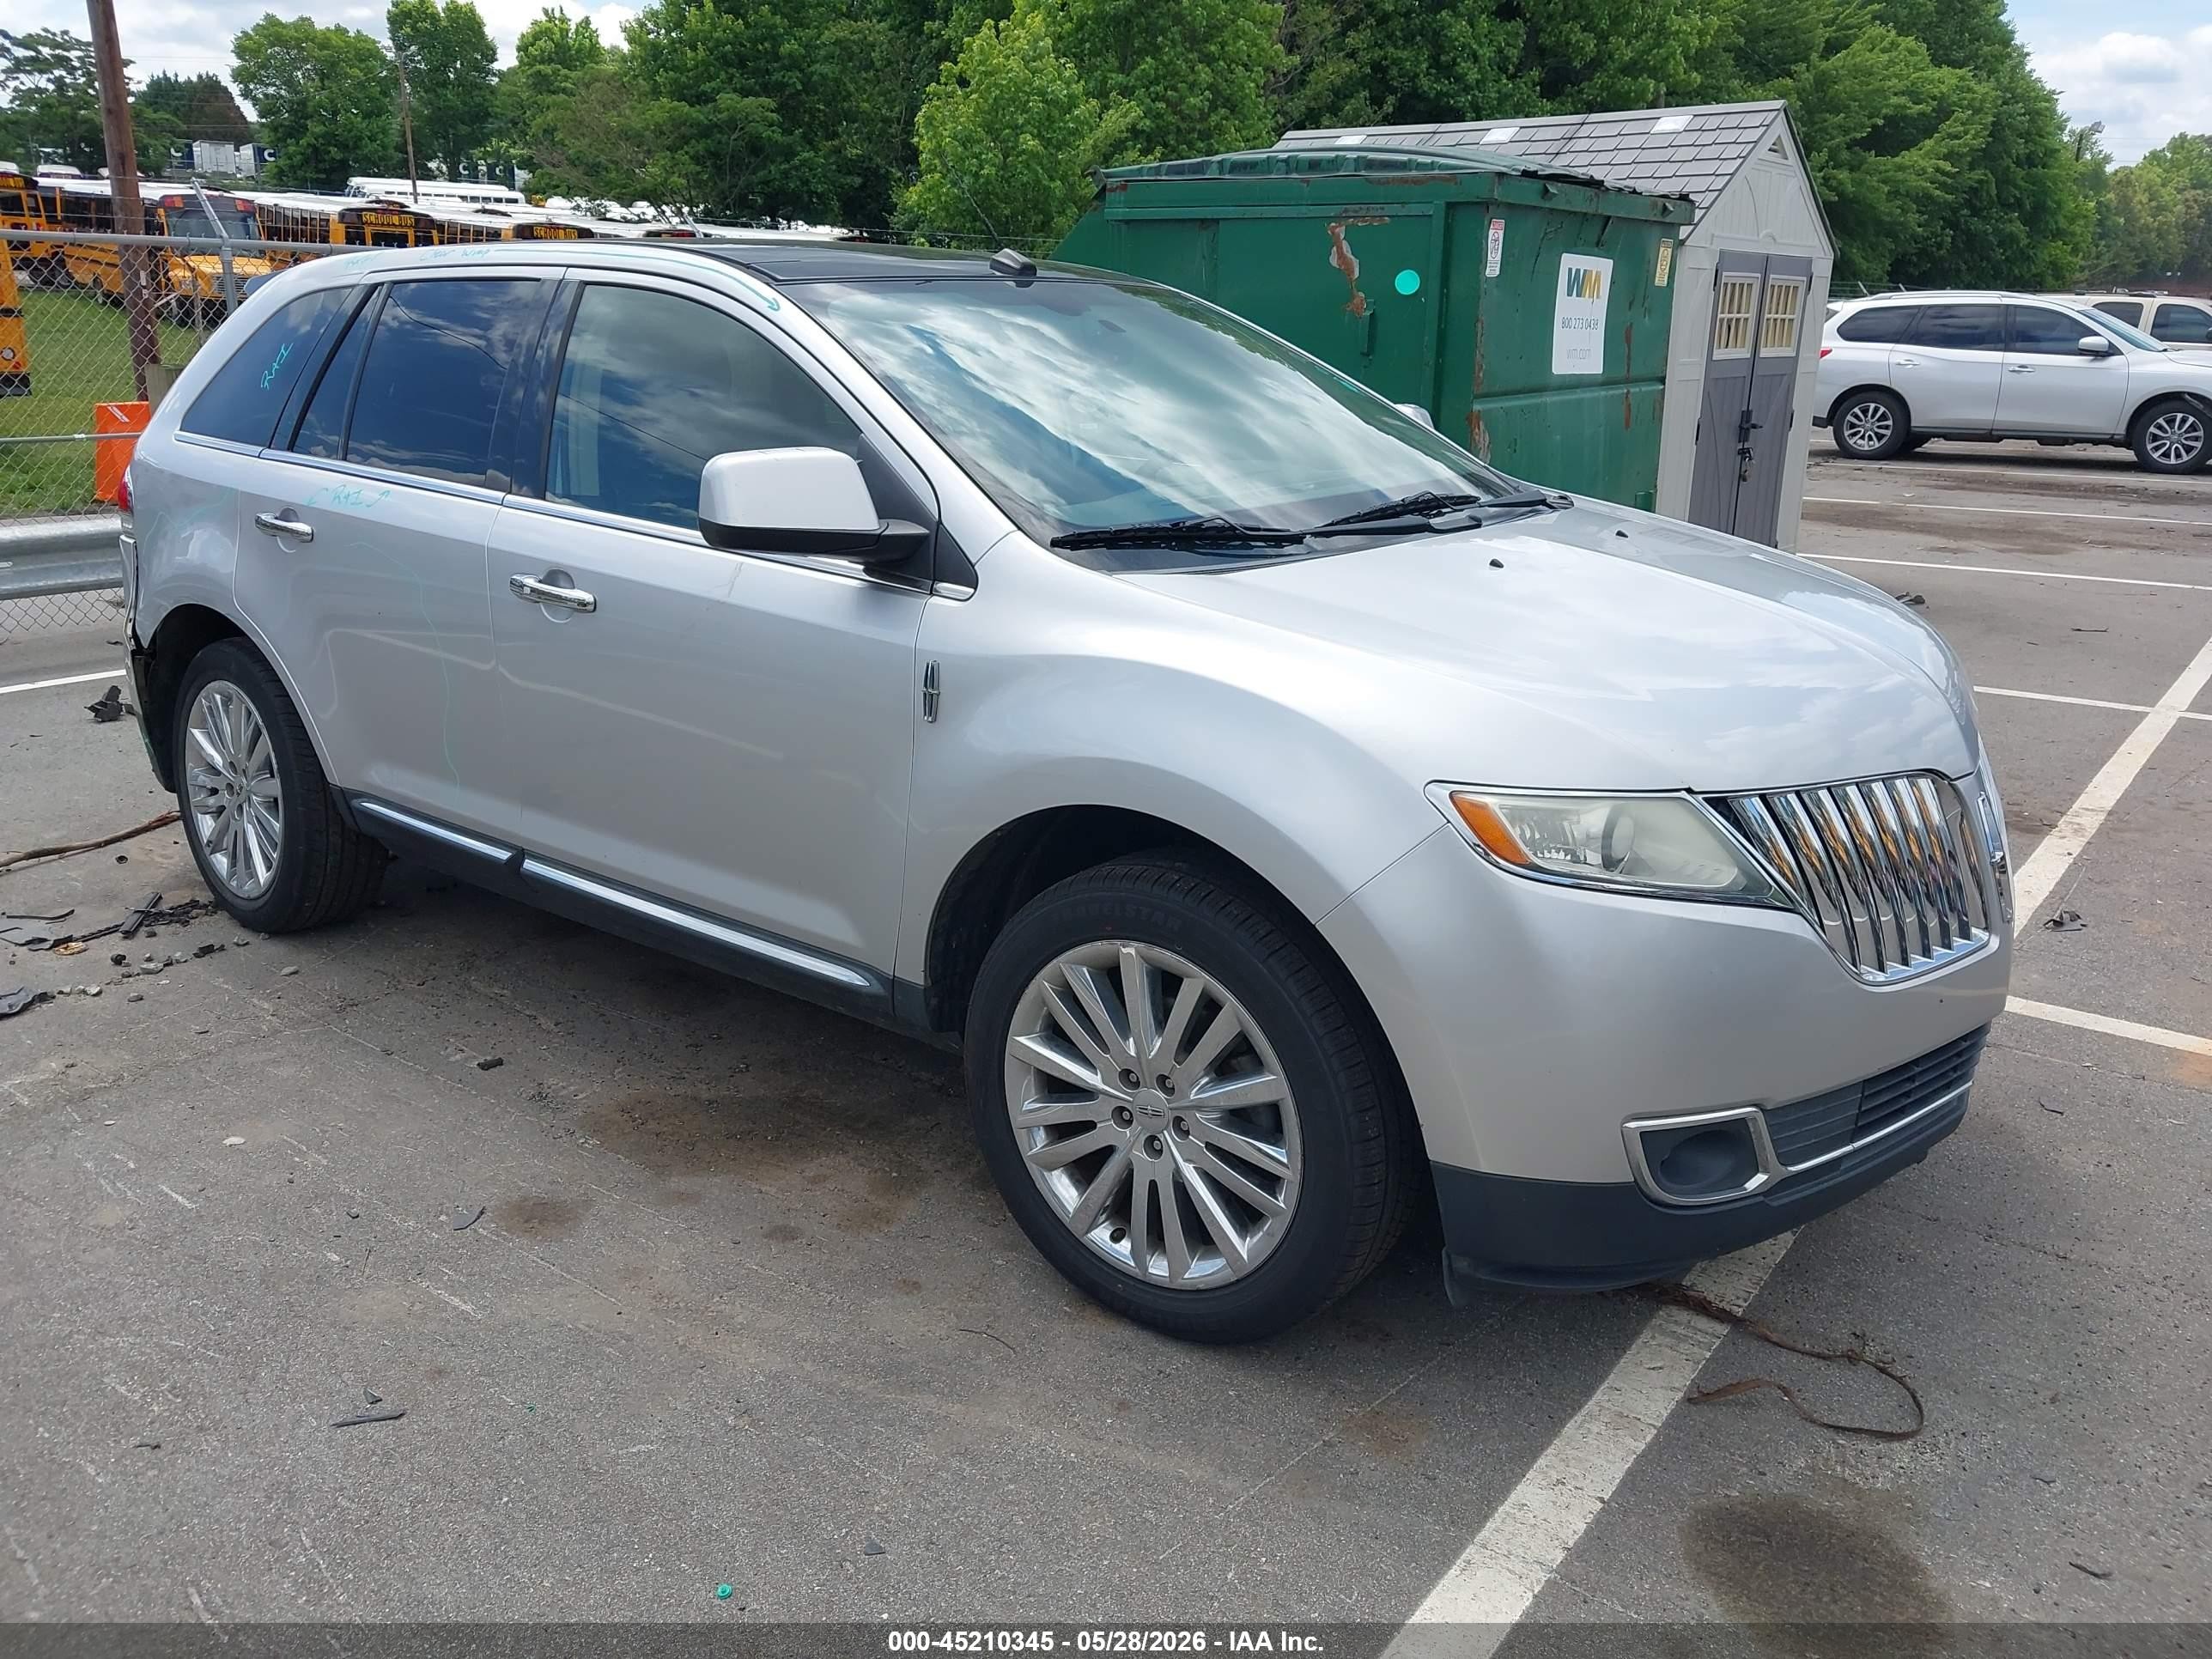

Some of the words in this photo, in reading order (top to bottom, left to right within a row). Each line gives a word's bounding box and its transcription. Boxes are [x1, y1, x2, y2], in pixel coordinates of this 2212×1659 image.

[363, 213, 393, 225] SCHOOL
[398, 216, 414, 227] BUS
[534, 227, 561, 240] SCHOOL
[1566, 267, 1602, 300] WM
[1560, 317, 1573, 330] 800
[1573, 317, 1584, 331] 273
